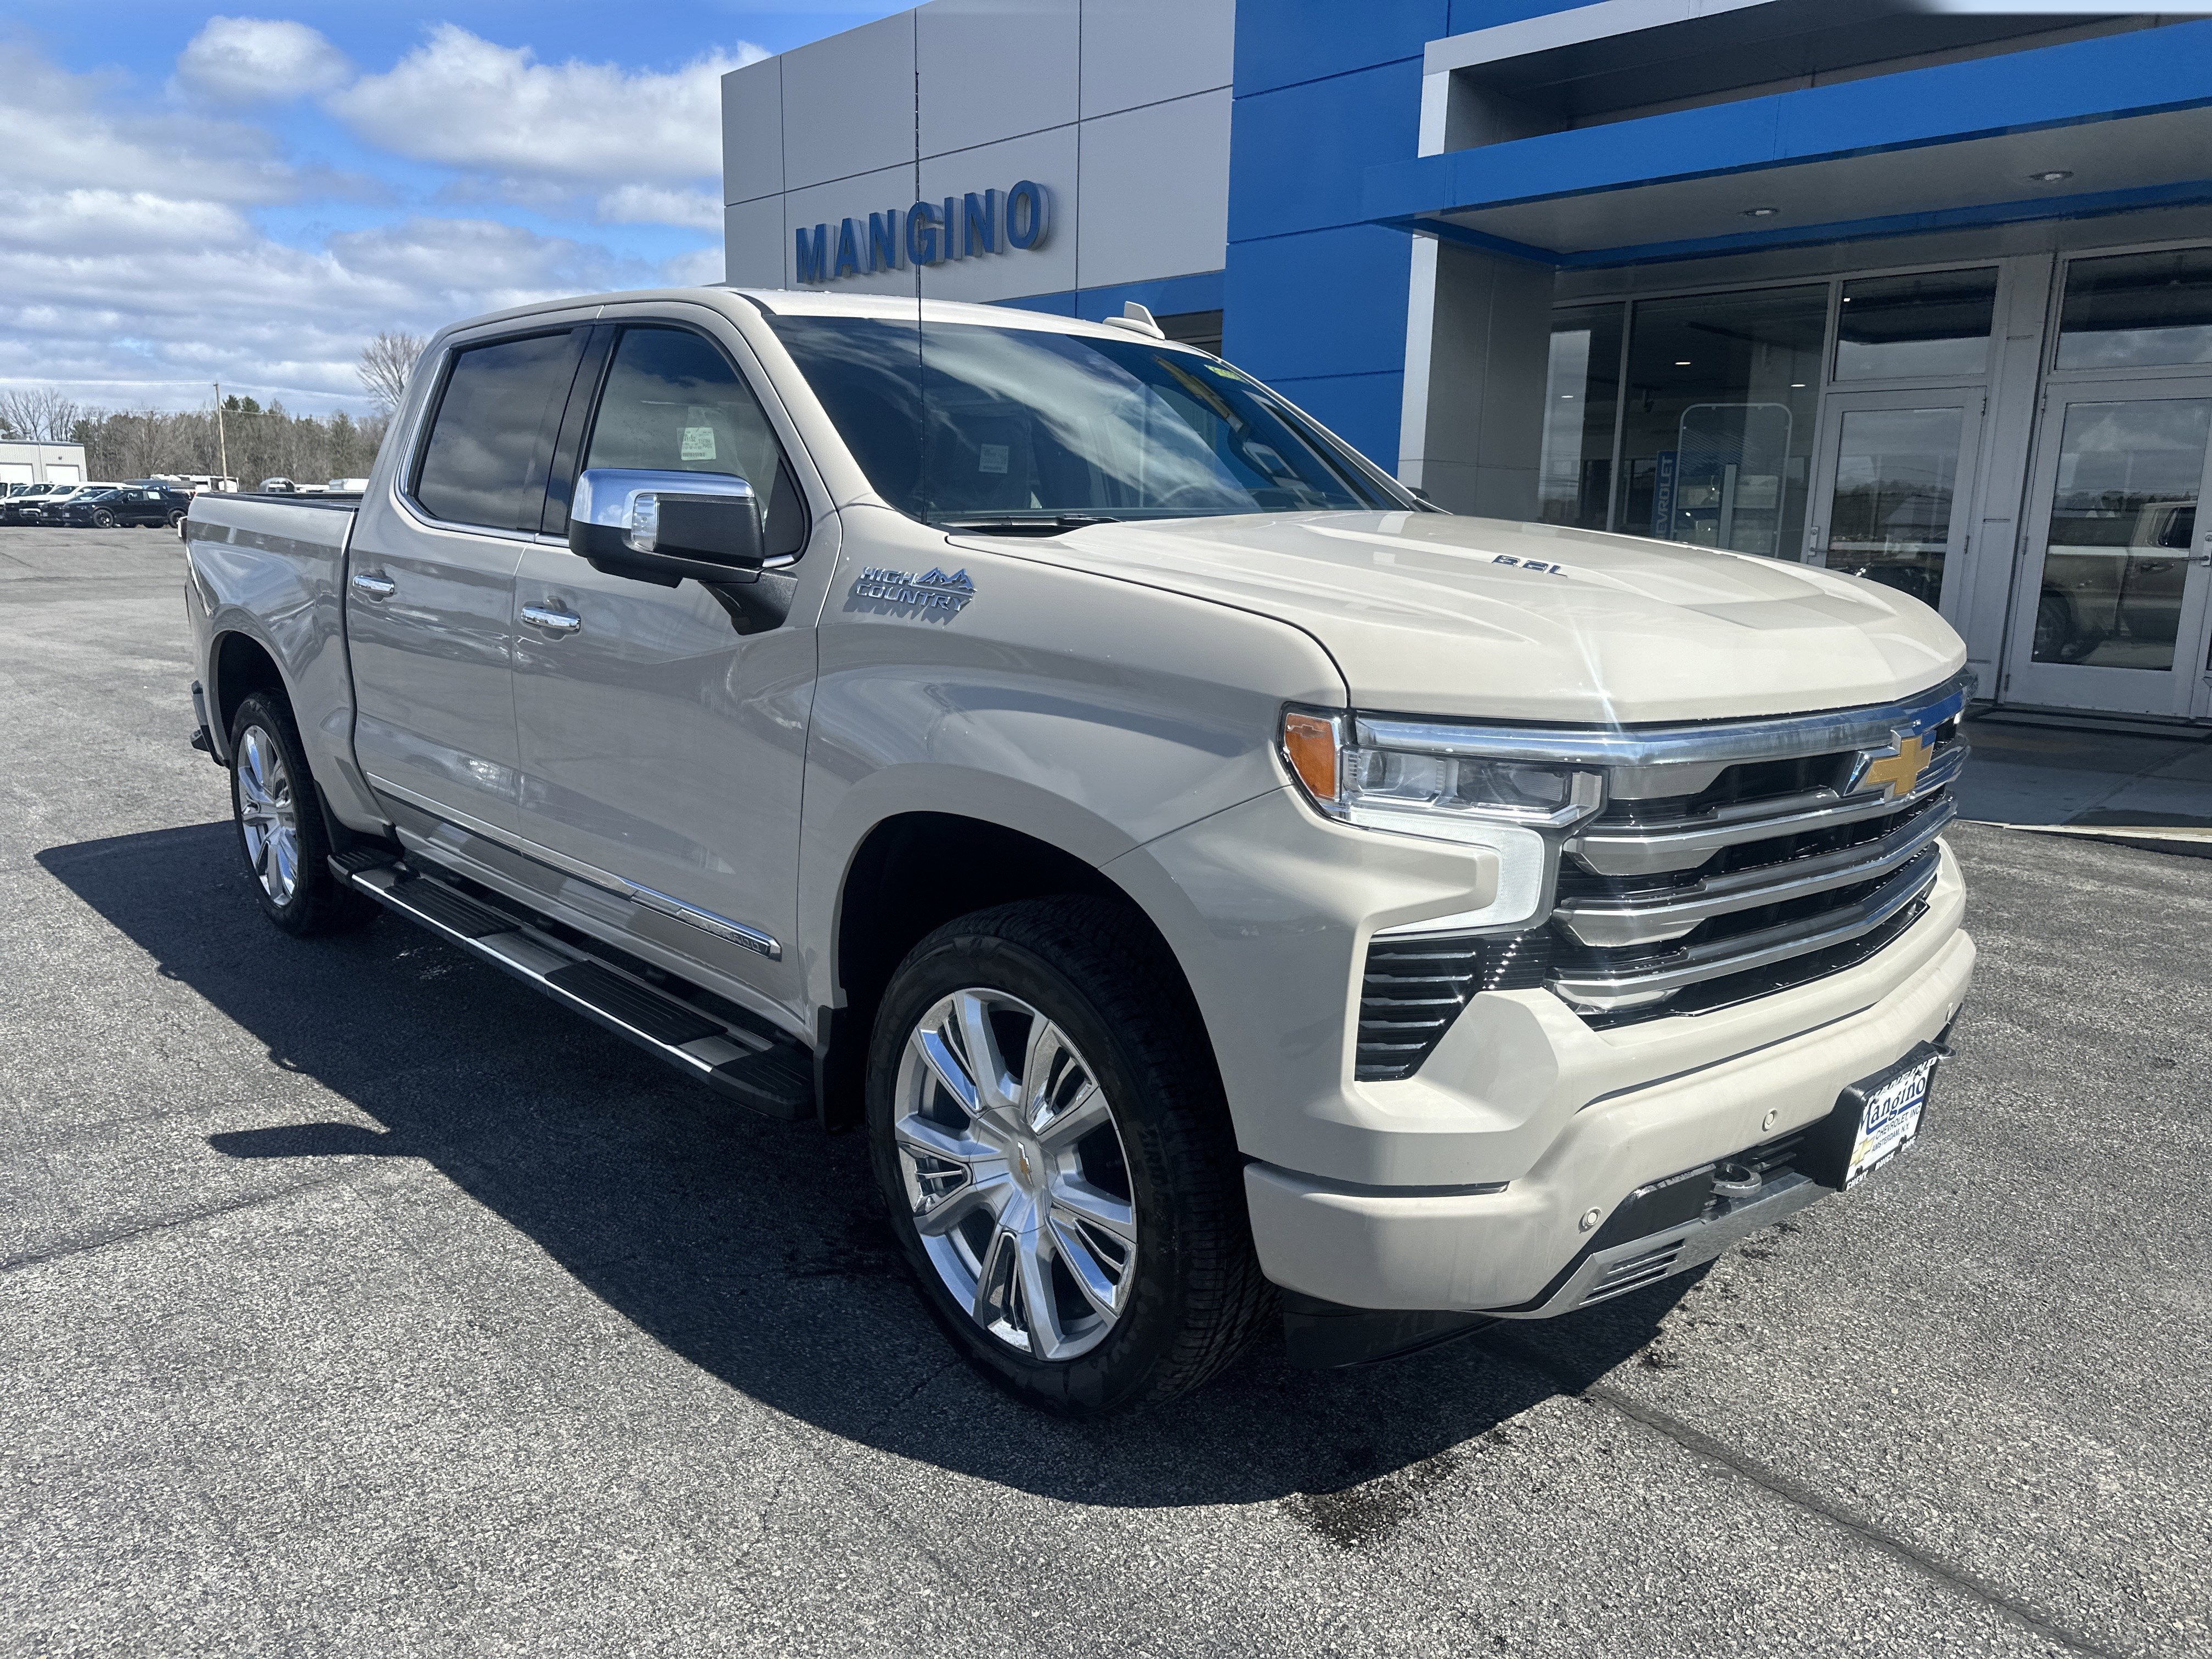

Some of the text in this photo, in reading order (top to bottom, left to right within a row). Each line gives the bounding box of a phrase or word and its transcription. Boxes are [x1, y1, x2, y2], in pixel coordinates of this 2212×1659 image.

[796, 180, 1049, 284] MANGINO
[1656, 455, 1673, 539] EVROLET
[856, 583, 962, 612] COUNTRY
[860, 567, 920, 586] HIGH
[1860, 1076, 1926, 1135] Mangino
[1846, 1136, 1916, 1191] CHEVY BUICK GMC
